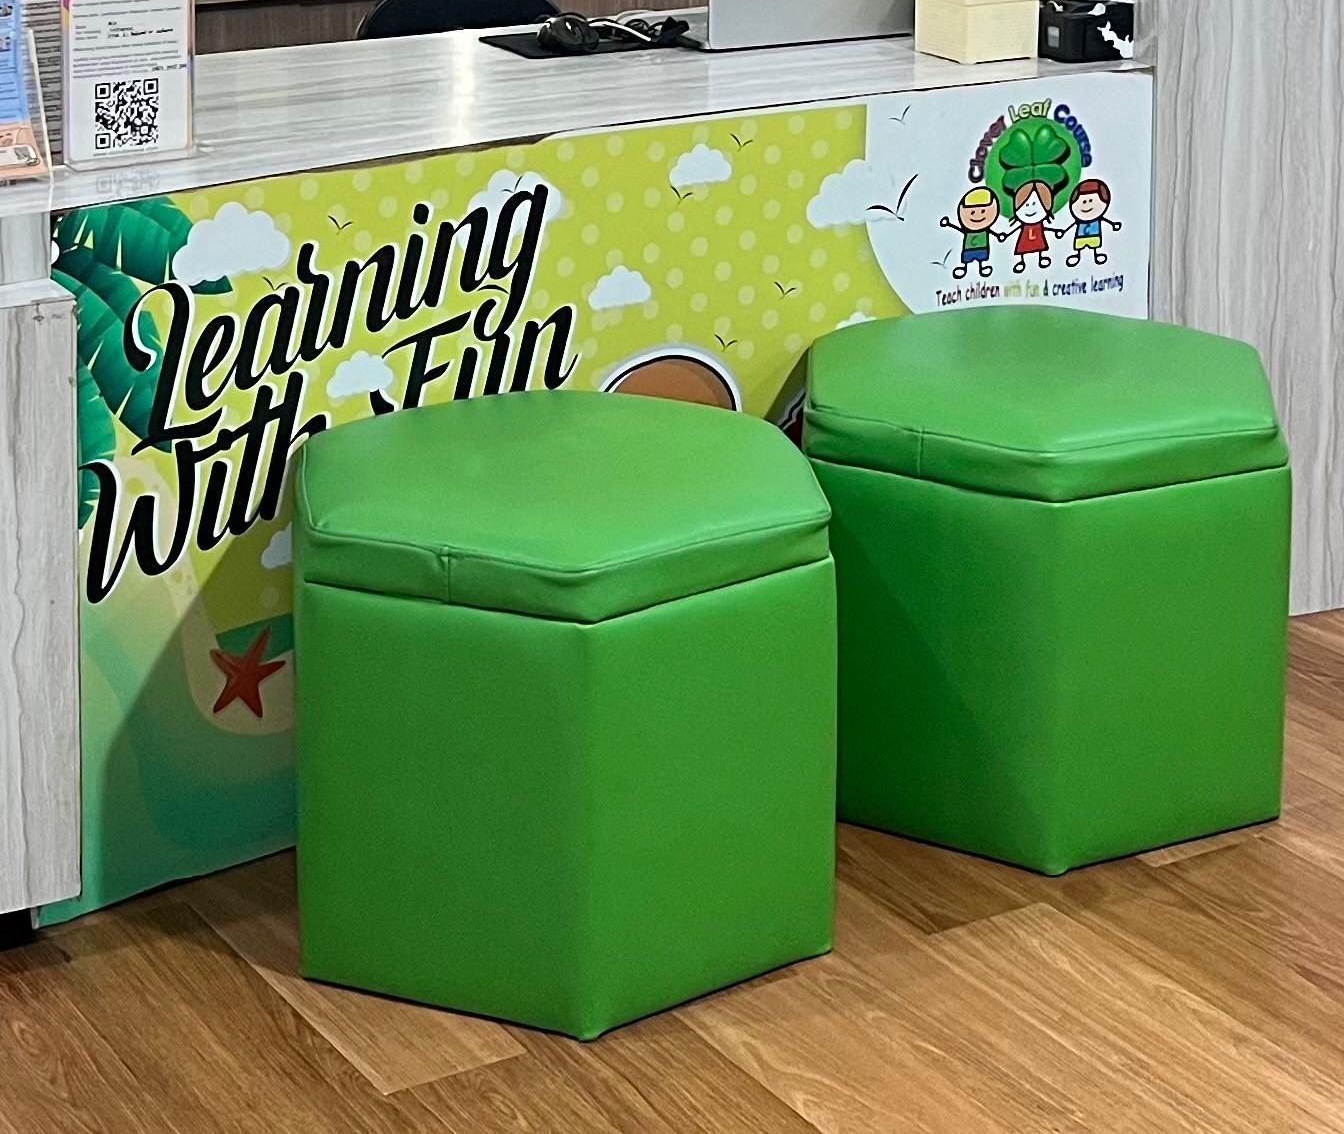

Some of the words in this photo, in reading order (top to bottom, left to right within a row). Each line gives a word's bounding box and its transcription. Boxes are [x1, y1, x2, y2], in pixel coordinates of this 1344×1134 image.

[968, 115, 1006, 183] Clover
[1008, 98, 1052, 124] Leaf
[1054, 104, 1093, 168] Course
[124, 183, 549, 455] Learning
[936, 286, 962, 306] Teach
[965, 281, 1000, 301] children
[1025, 280, 1040, 298] fun
[1052, 277, 1087, 296] creative
[1090, 272, 1124, 293] learning
[78, 371, 328, 604] With
